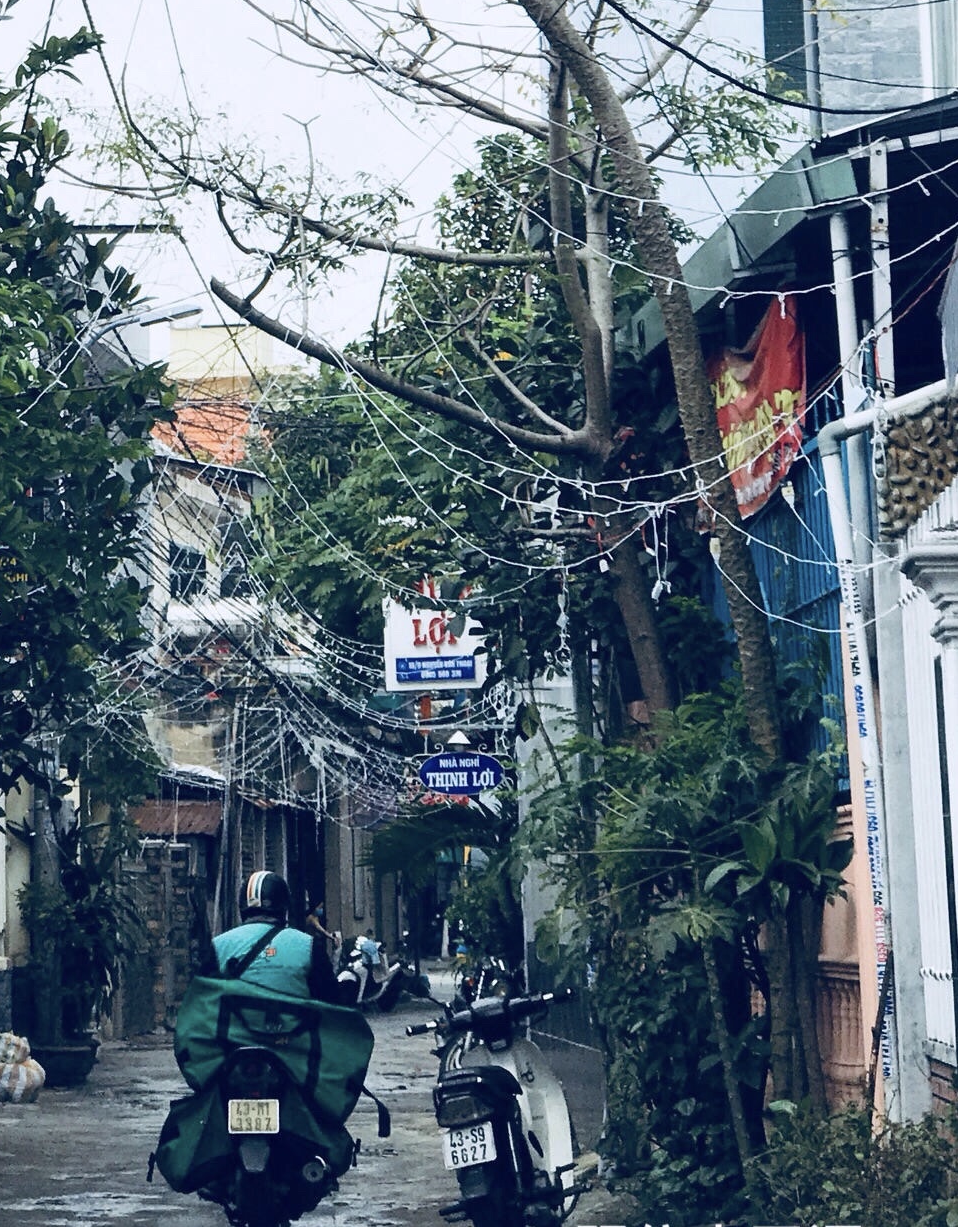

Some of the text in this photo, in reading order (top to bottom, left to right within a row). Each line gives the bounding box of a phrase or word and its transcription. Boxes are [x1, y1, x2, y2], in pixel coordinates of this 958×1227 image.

[439, 755, 480, 768] NHÀ NGHỈ
[426, 767, 495, 791] THỊNH LỢI
[451, 1143, 487, 1165] 6627
